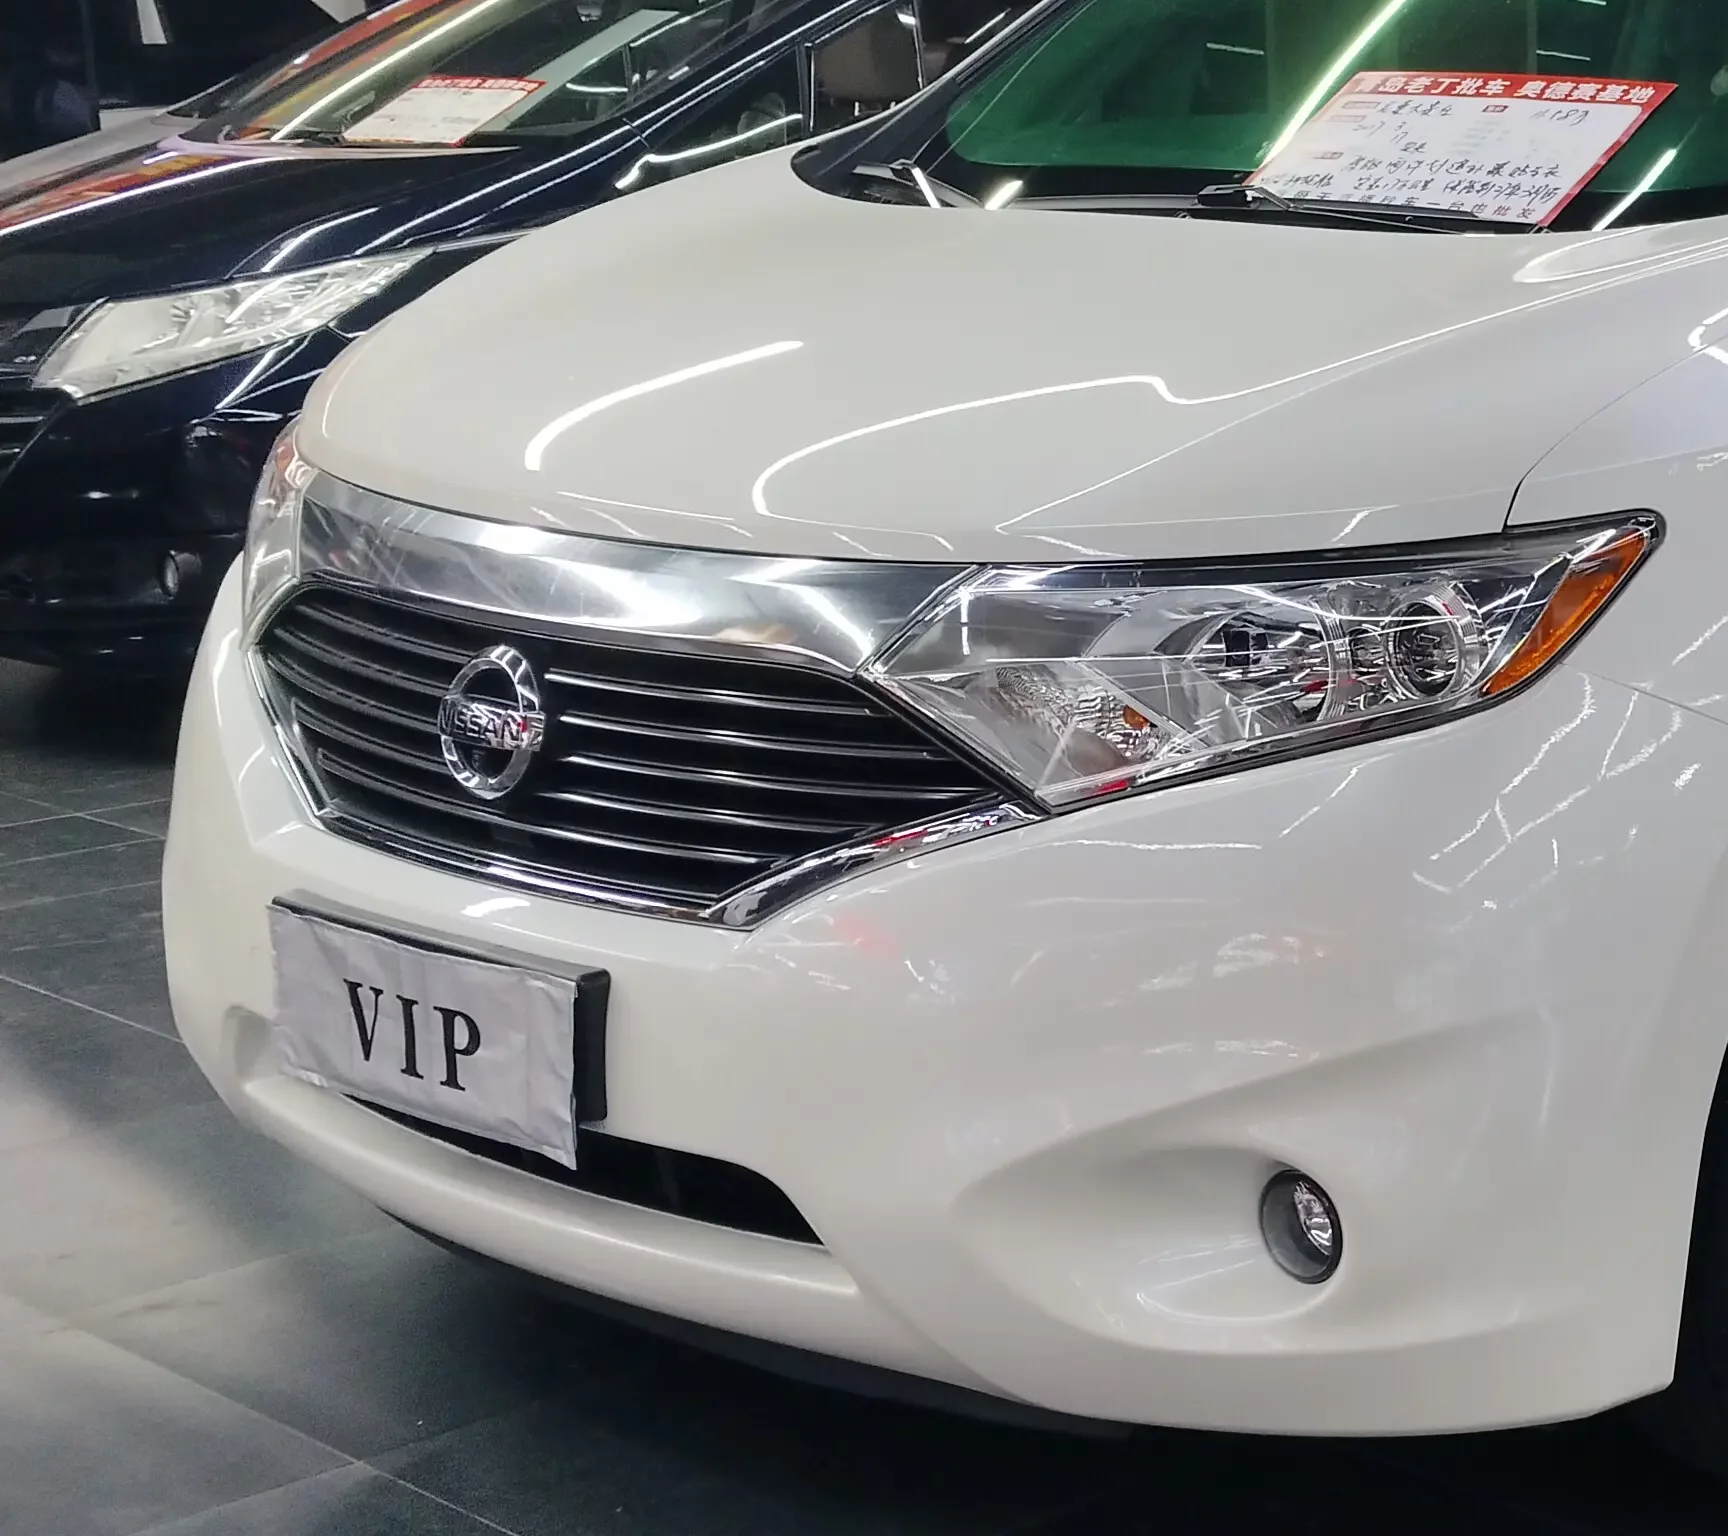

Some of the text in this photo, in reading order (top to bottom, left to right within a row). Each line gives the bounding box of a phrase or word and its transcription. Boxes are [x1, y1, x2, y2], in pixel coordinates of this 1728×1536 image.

[1513, 80, 1656, 104] 奥德赛基地
[342, 978, 481, 1092] VIP
